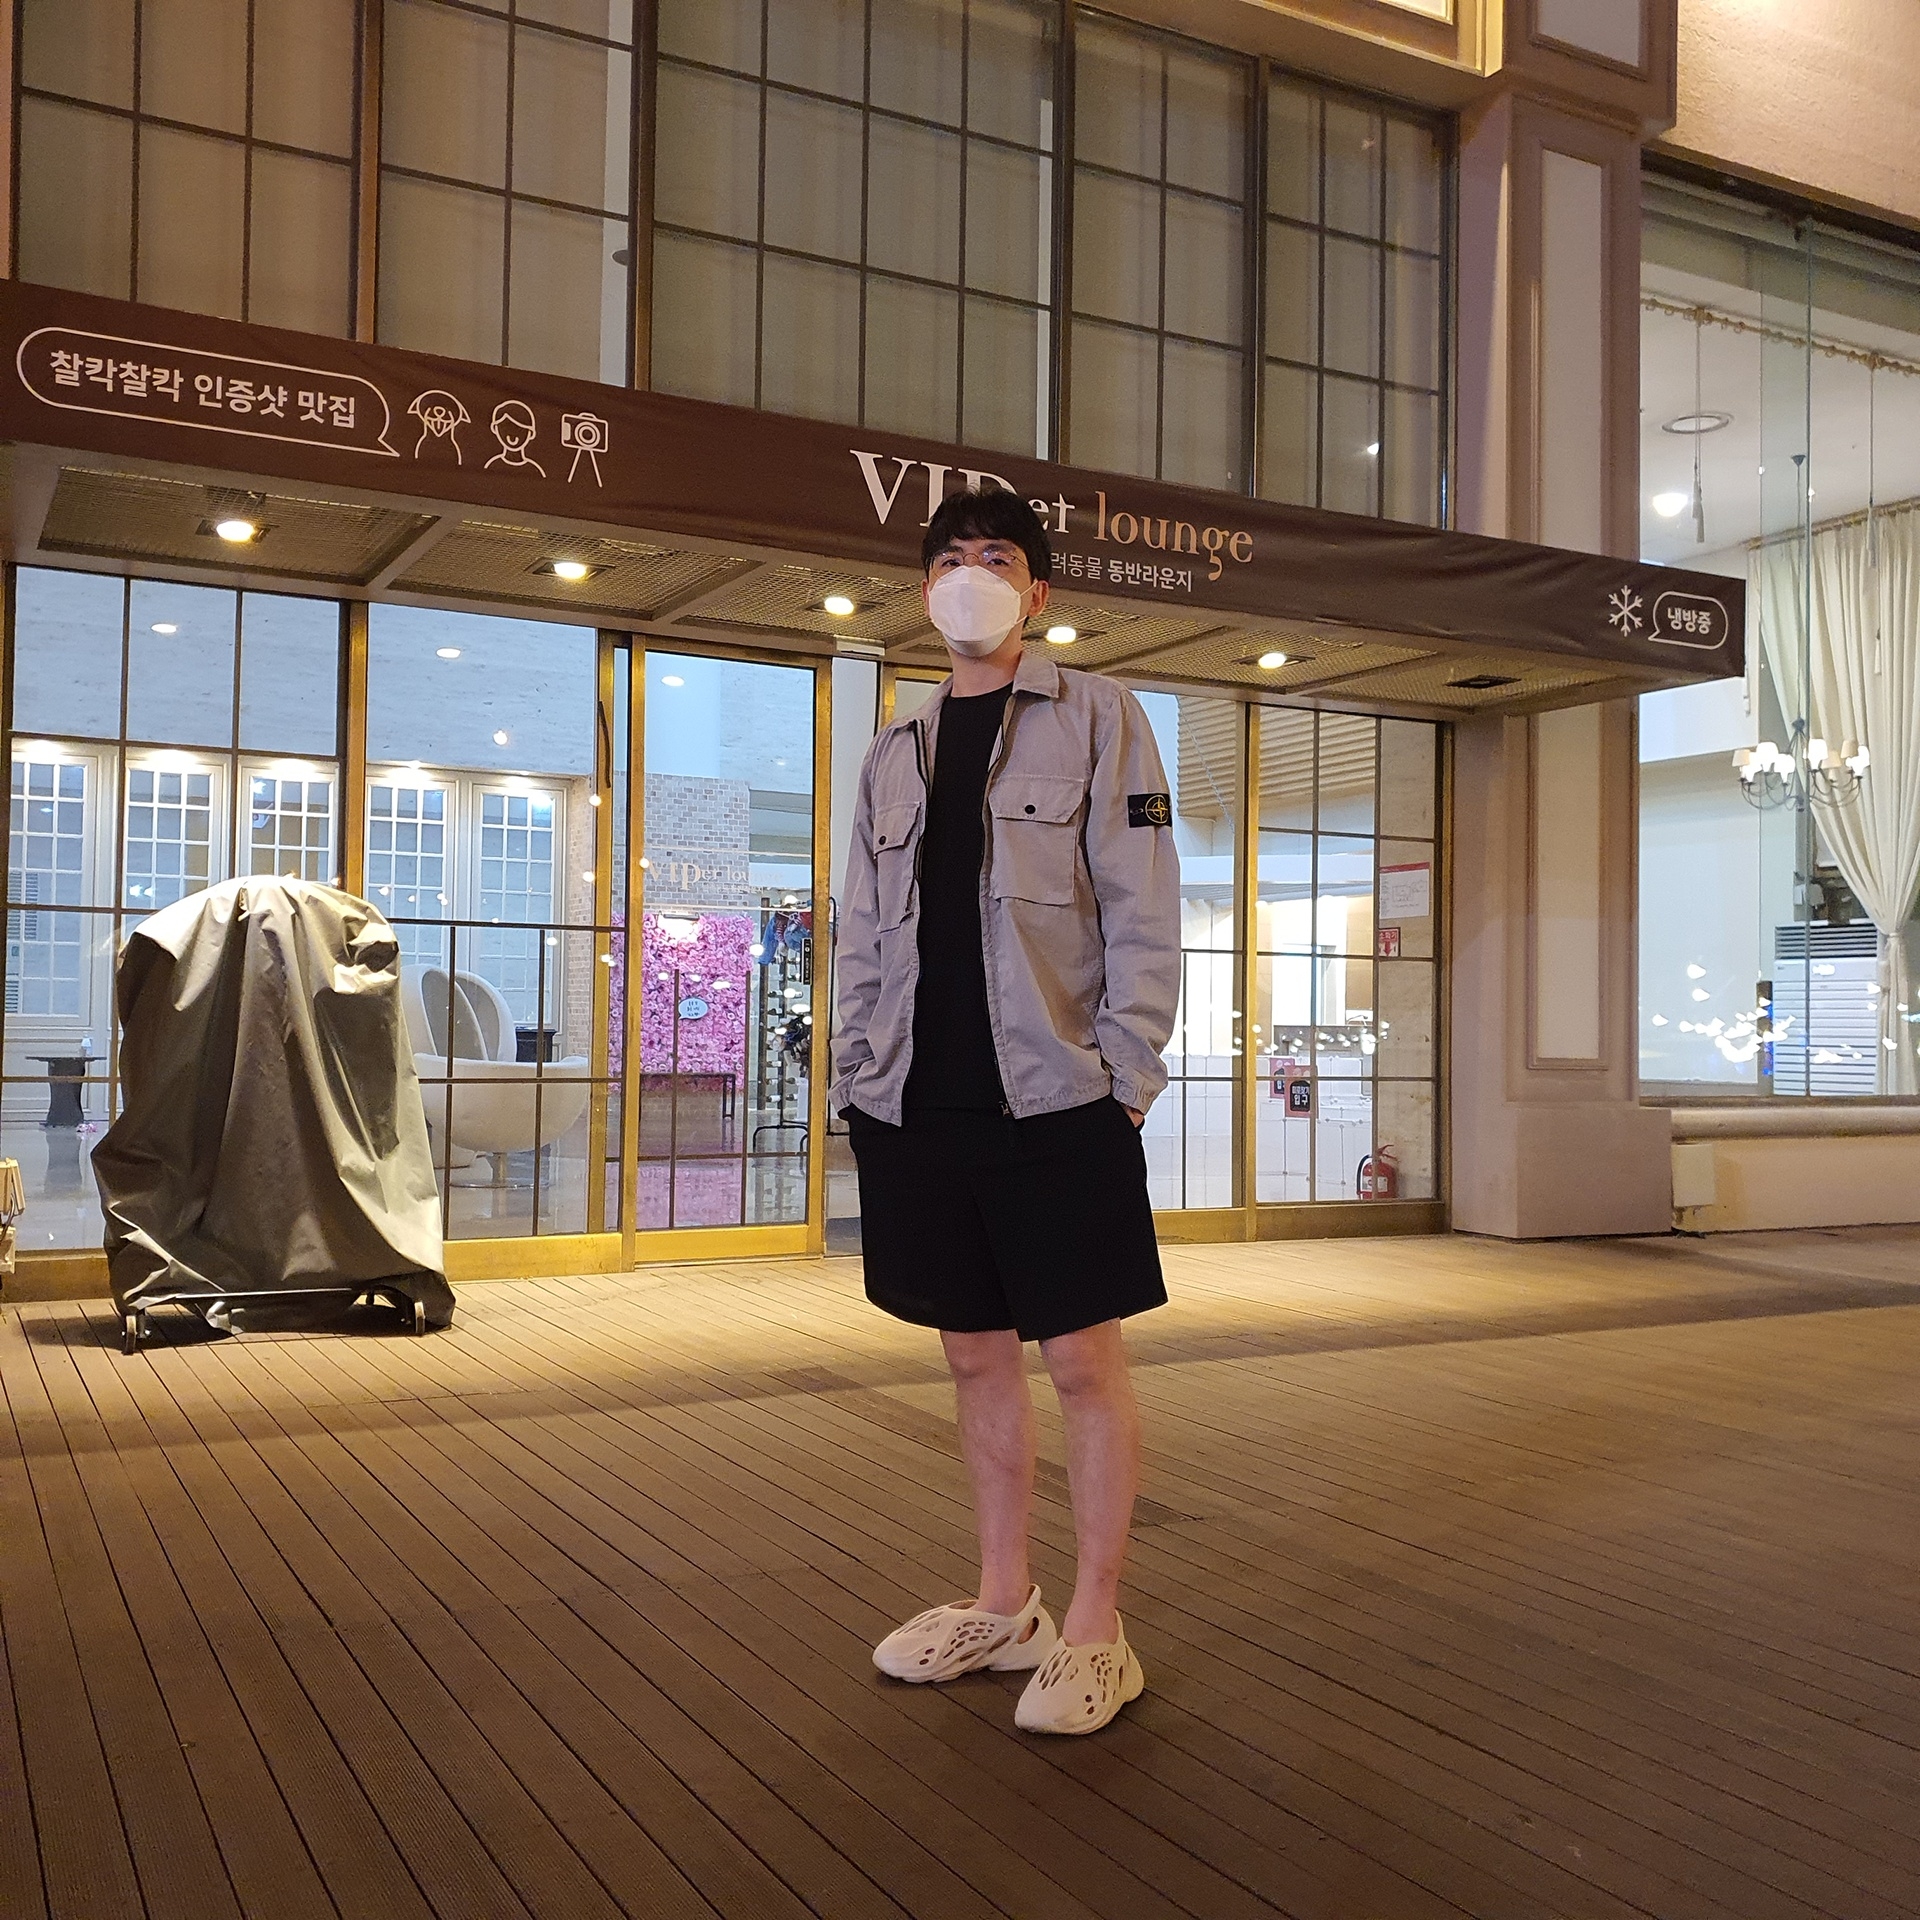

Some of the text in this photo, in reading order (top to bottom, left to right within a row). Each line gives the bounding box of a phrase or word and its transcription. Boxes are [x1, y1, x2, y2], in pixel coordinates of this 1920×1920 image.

[50, 350, 356, 429] 찰칵찰칵 인증샷 맛집
[1094, 490, 1253, 581] lounge
[1051, 552, 1192, 592] 려동물 동반라운지
[1667, 607, 1711, 634] 냉방중
